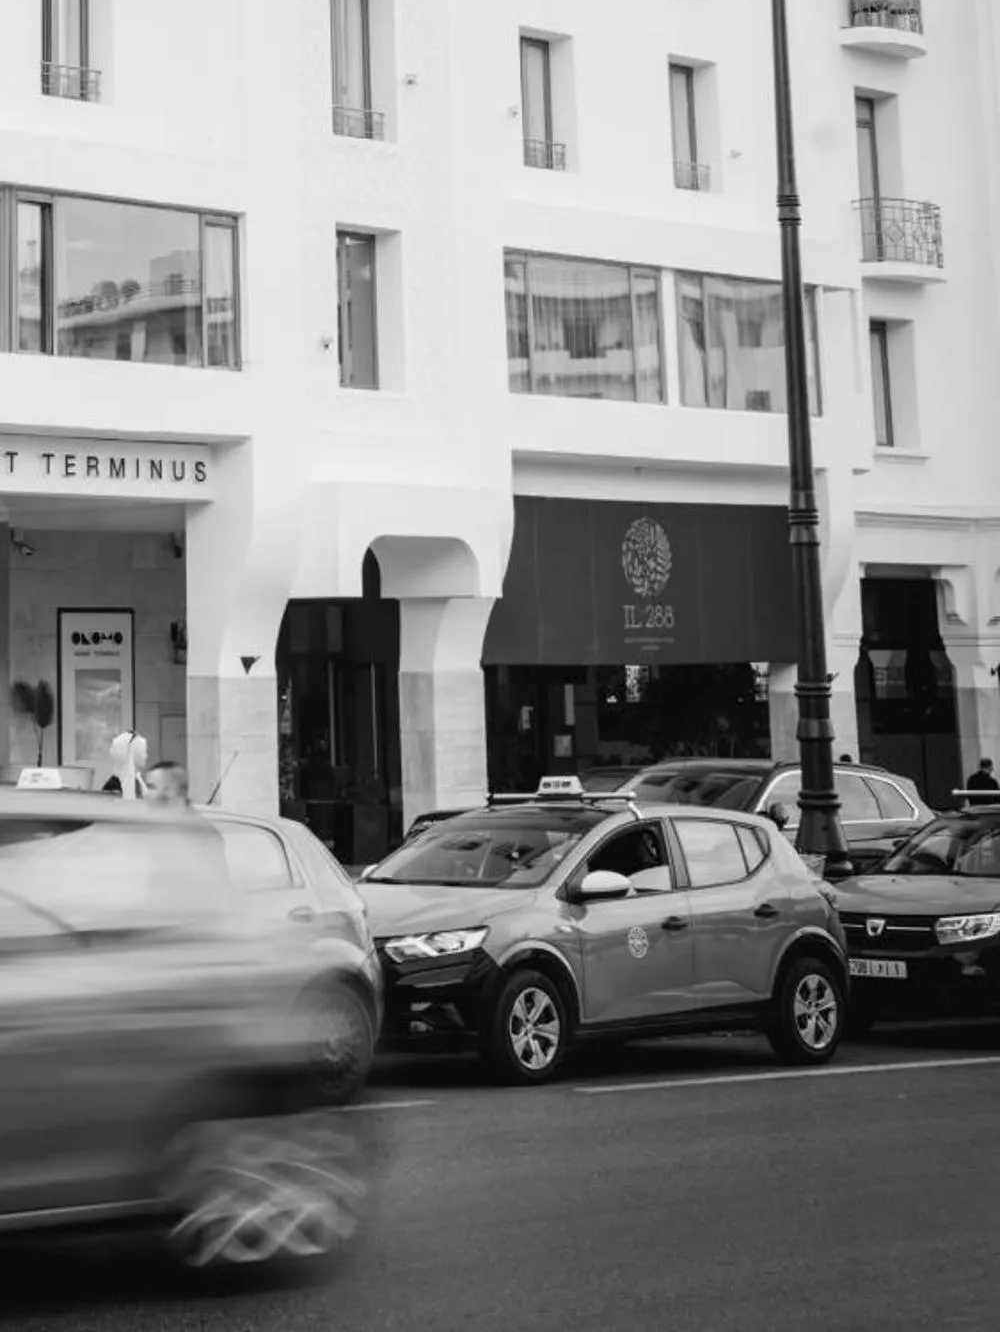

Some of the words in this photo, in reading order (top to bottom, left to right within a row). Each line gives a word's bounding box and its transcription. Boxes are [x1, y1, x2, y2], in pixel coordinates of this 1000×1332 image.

[43, 453, 207, 482] TERMINUS
[622, 604, 643, 629] IL
[645, 604, 675, 629] 288
[71, 631, 123, 646] ONOMO
